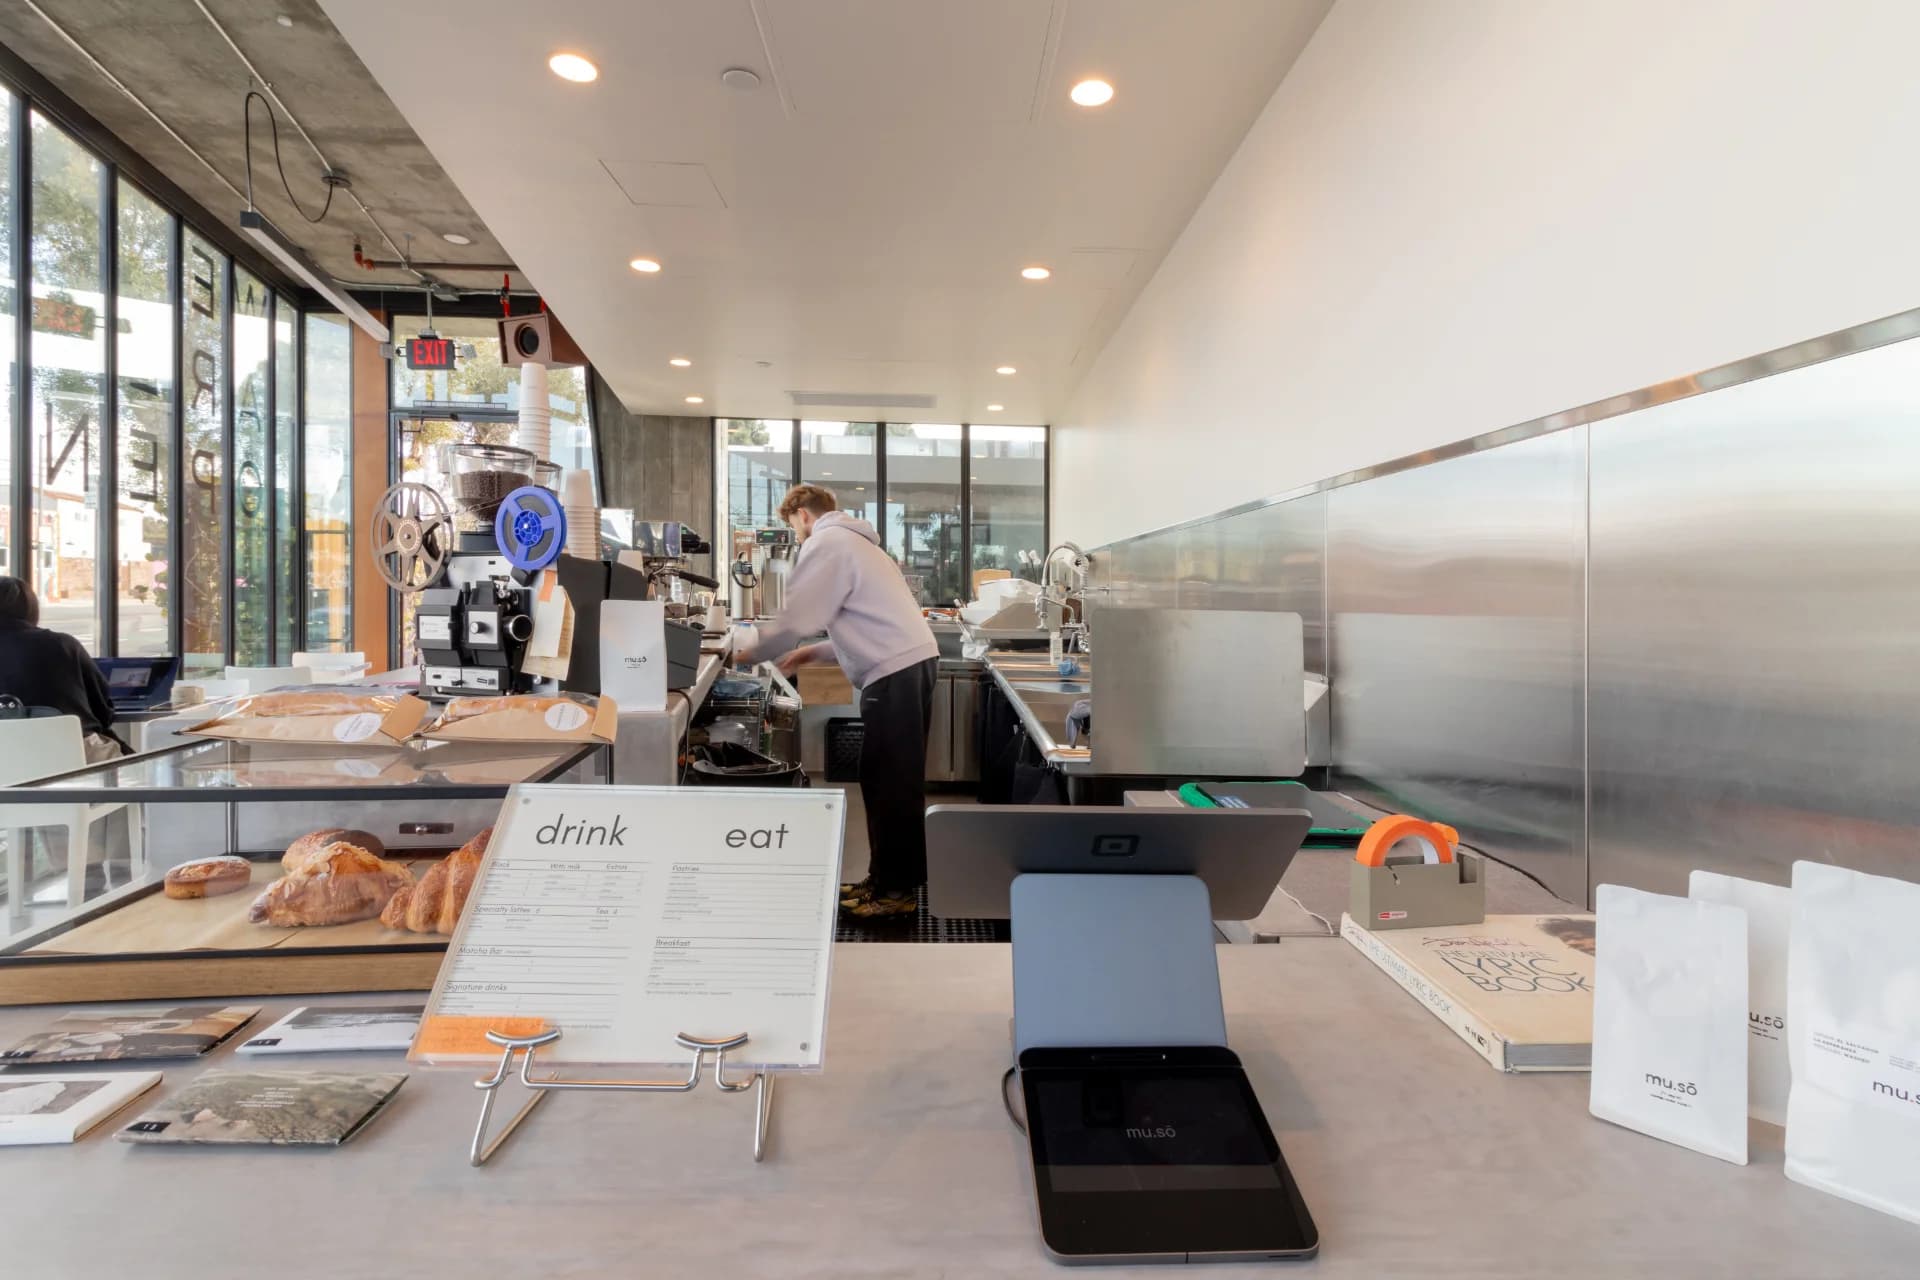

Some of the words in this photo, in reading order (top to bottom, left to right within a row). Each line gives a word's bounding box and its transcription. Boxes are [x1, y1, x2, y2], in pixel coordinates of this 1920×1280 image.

[413, 340, 448, 365] EXIT
[536, 813, 628, 846] drink
[725, 823, 789, 849] eat
[1441, 957, 1578, 976] LYRIC
[1467, 976, 1594, 992] BOOK
[1749, 1011, 1784, 1029] u.sō
